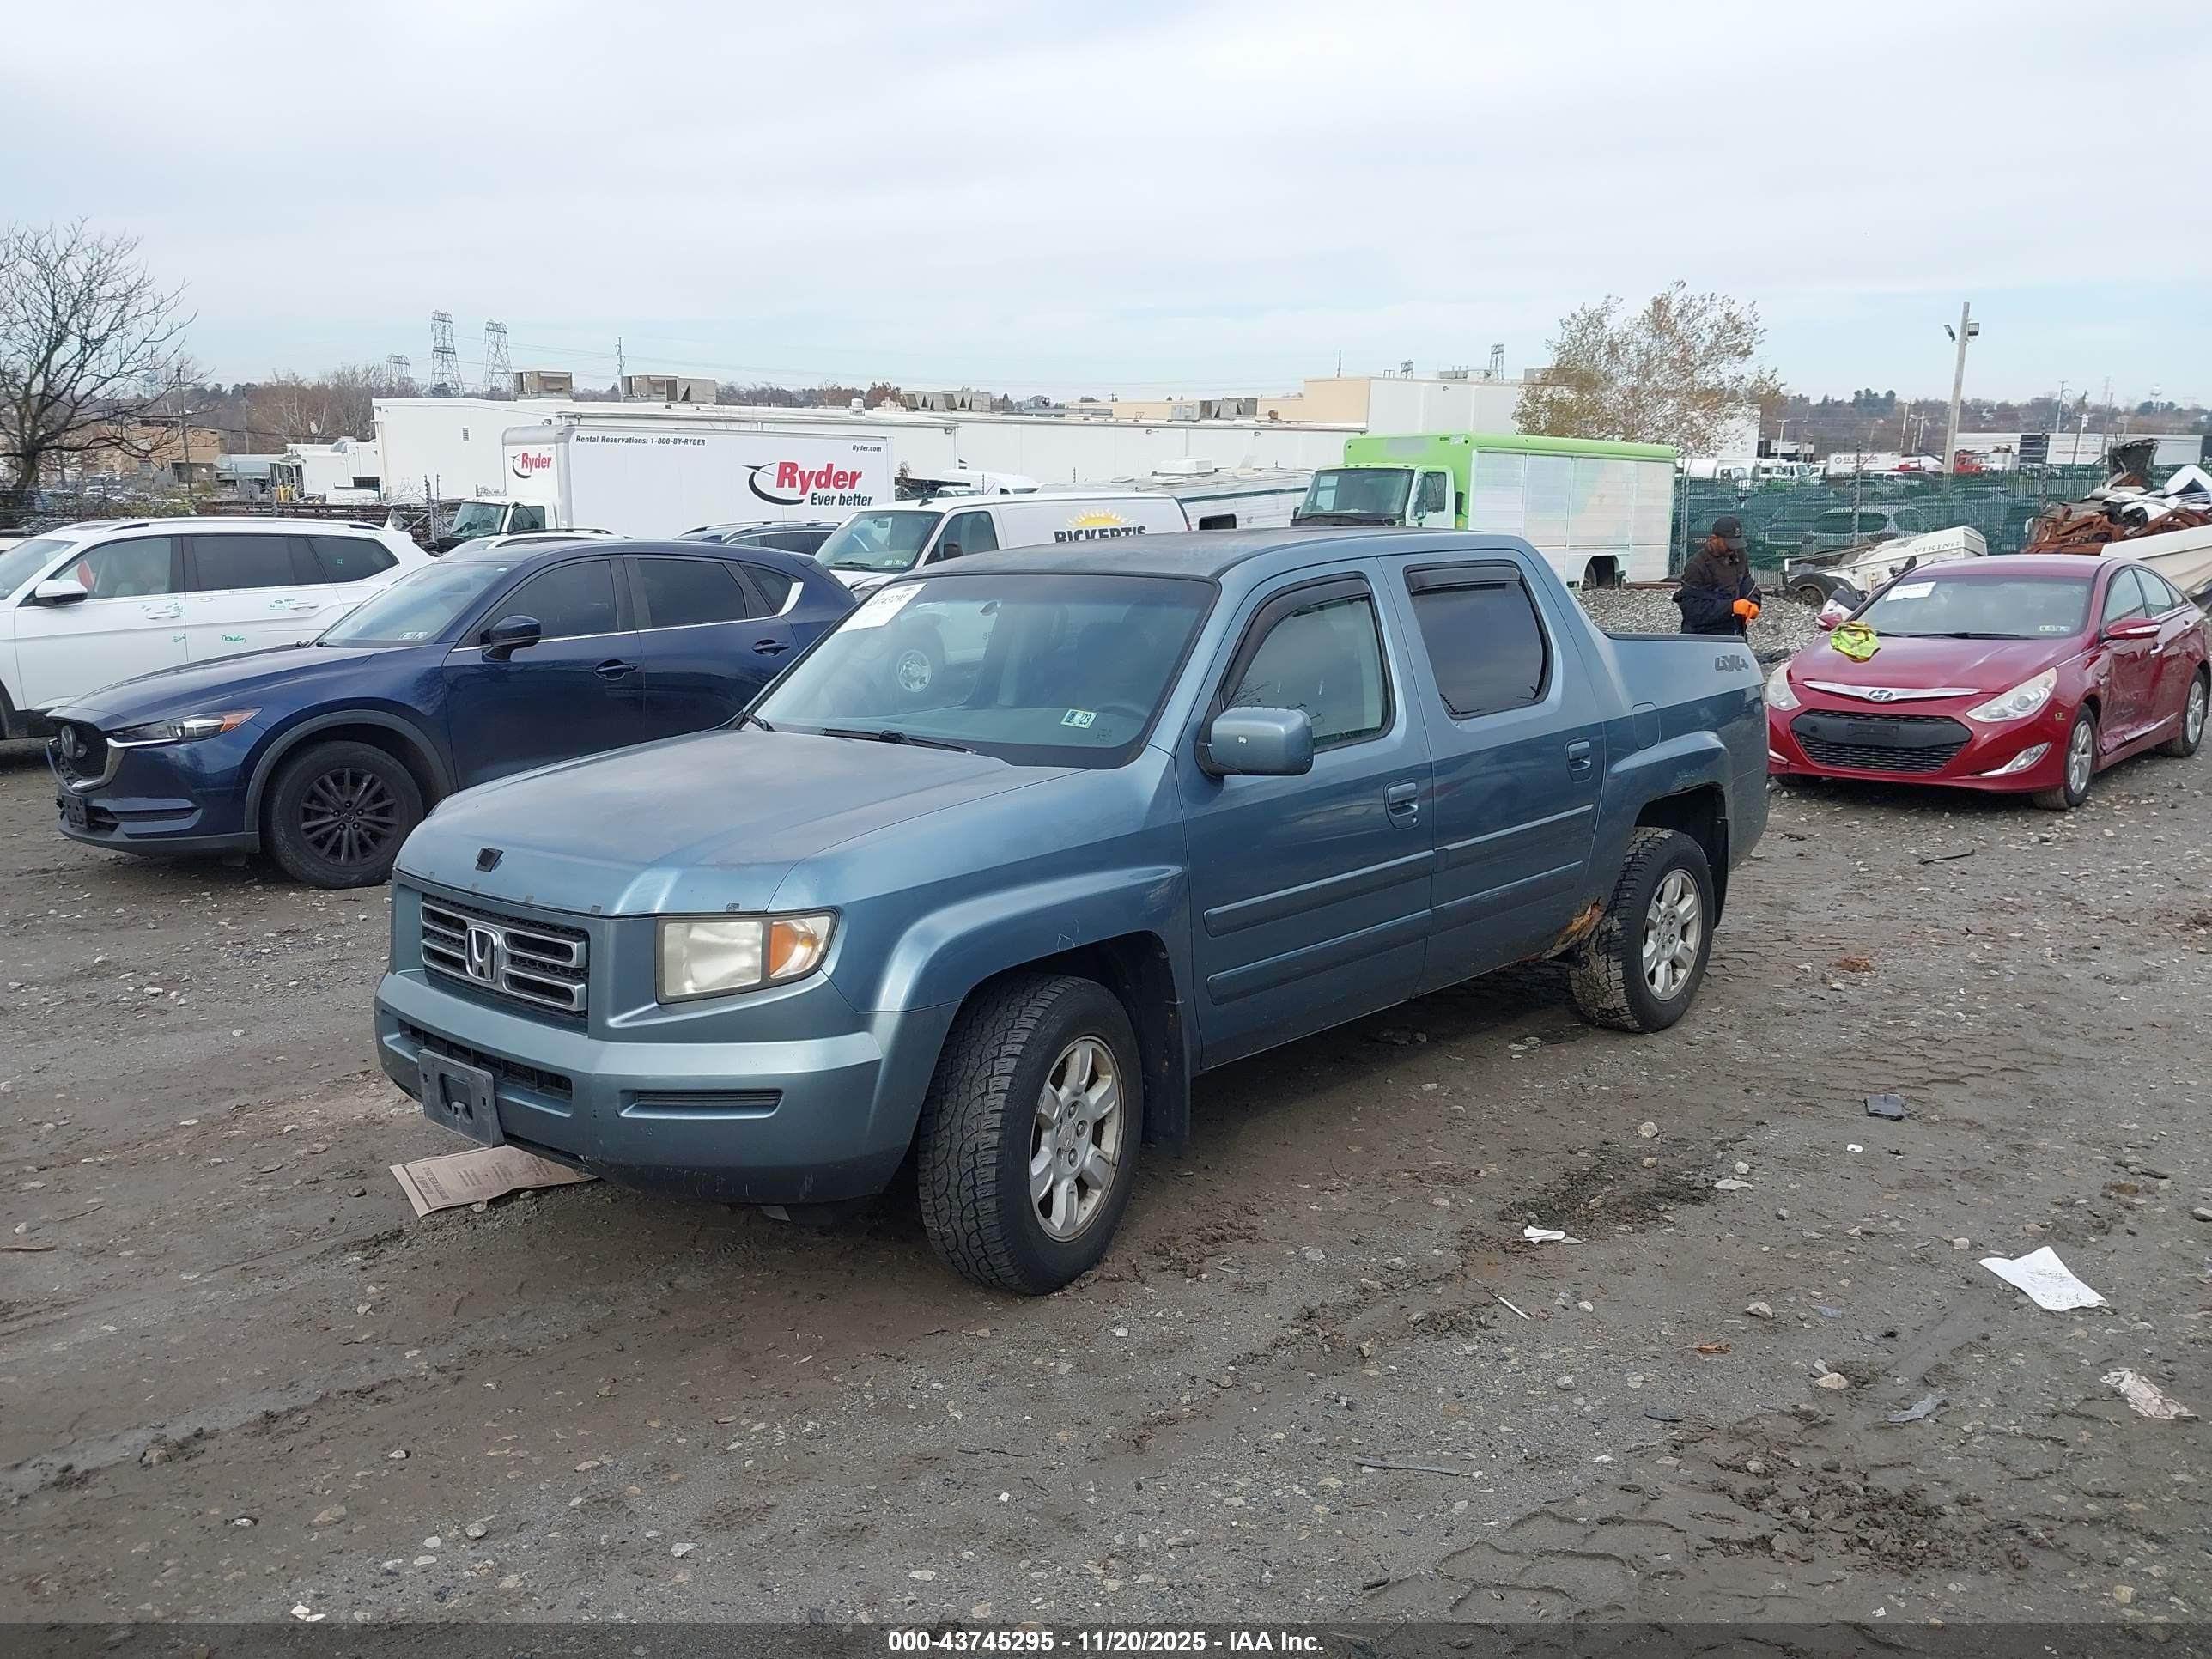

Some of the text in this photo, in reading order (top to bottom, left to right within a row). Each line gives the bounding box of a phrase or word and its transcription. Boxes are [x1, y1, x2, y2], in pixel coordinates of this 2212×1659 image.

[575, 434, 706, 446] Rental Reservations: 1-800-BY-RYDER
[852, 444, 882, 453] Ryder.com
[521, 452, 552, 473] Ryder
[775, 461, 862, 495] Ryder
[810, 492, 873, 507] Ever better.
